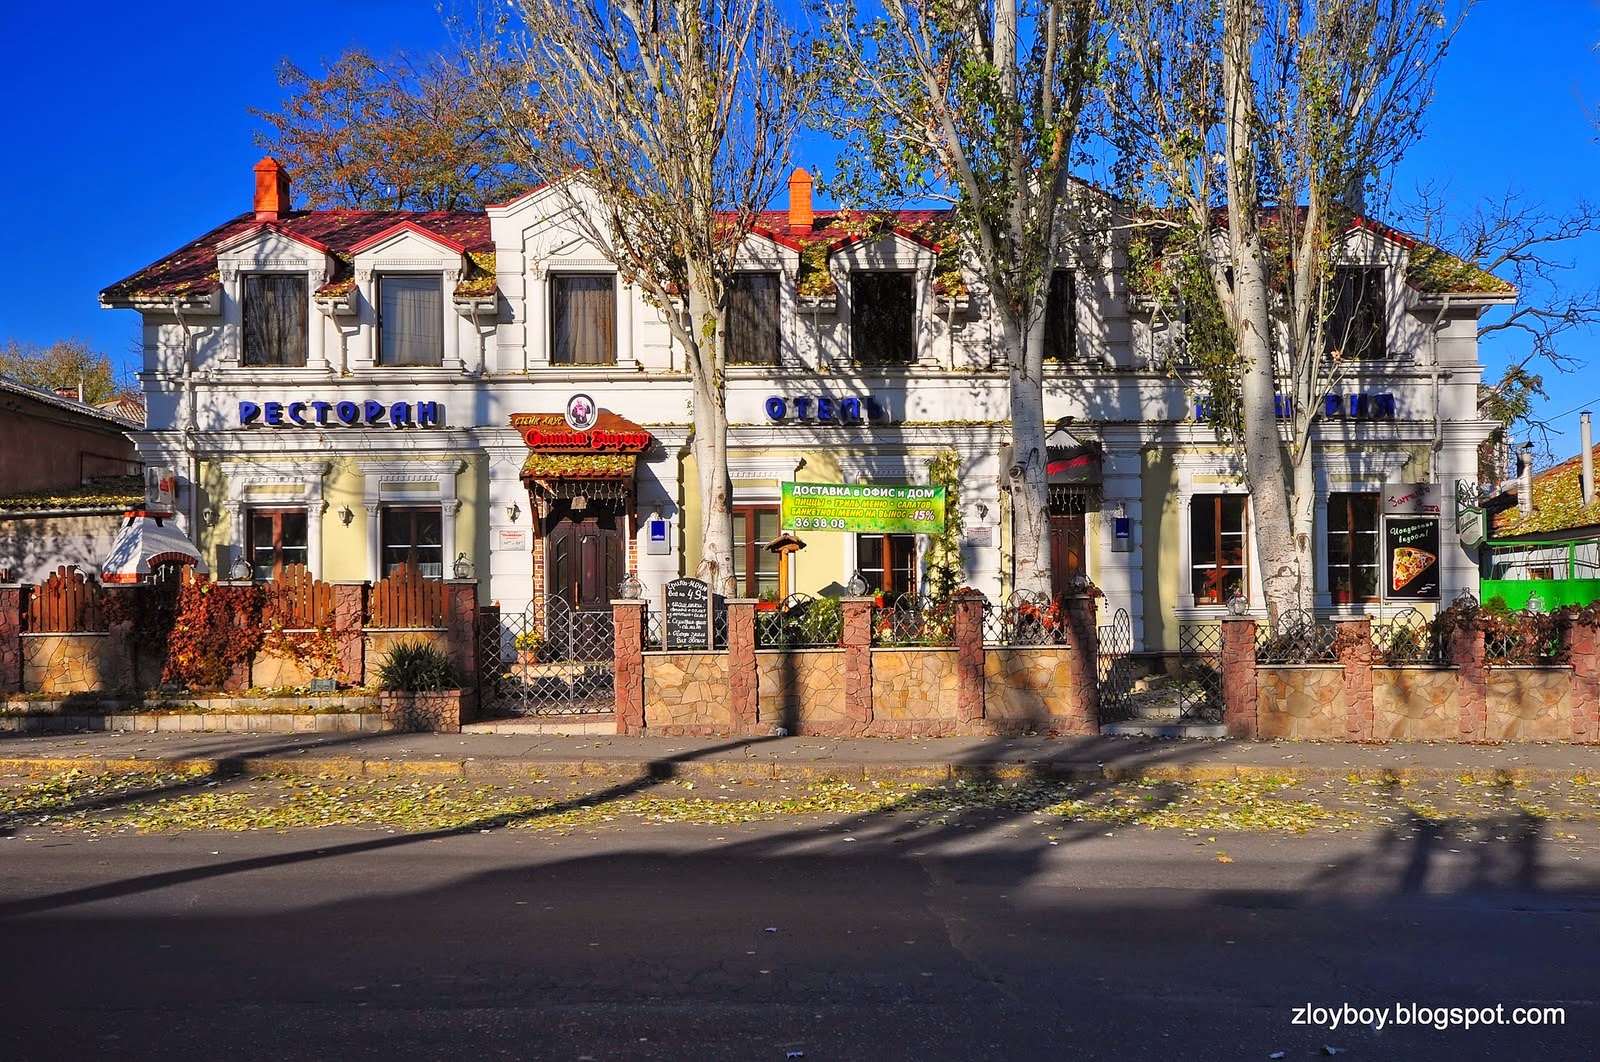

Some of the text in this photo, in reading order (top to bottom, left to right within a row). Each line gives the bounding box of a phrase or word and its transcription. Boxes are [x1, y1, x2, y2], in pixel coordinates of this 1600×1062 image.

[239, 400, 438, 425] РЕСТОРАН
[765, 395, 884, 421] ОТЕЛЬ
[514, 414, 565, 426] СТЕЙК ХАУС
[525, 429, 650, 449] Сытый Бюргер
[792, 485, 851, 497] ДОСТАВКА
[862, 488, 895, 498] ОФИС
[906, 489, 935, 499] ДОМ
[794, 498, 931, 509] ПИЦЦЫ ГРИЛЬ МЕНЮ САЛАТОВ
[791, 508, 935, 521] БАНКЕТНОЕ МЕНЮ НА ВЫНОС -15%
[795, 517, 846, 528] 36 38 08
[687, 588, 702, 600] 49
